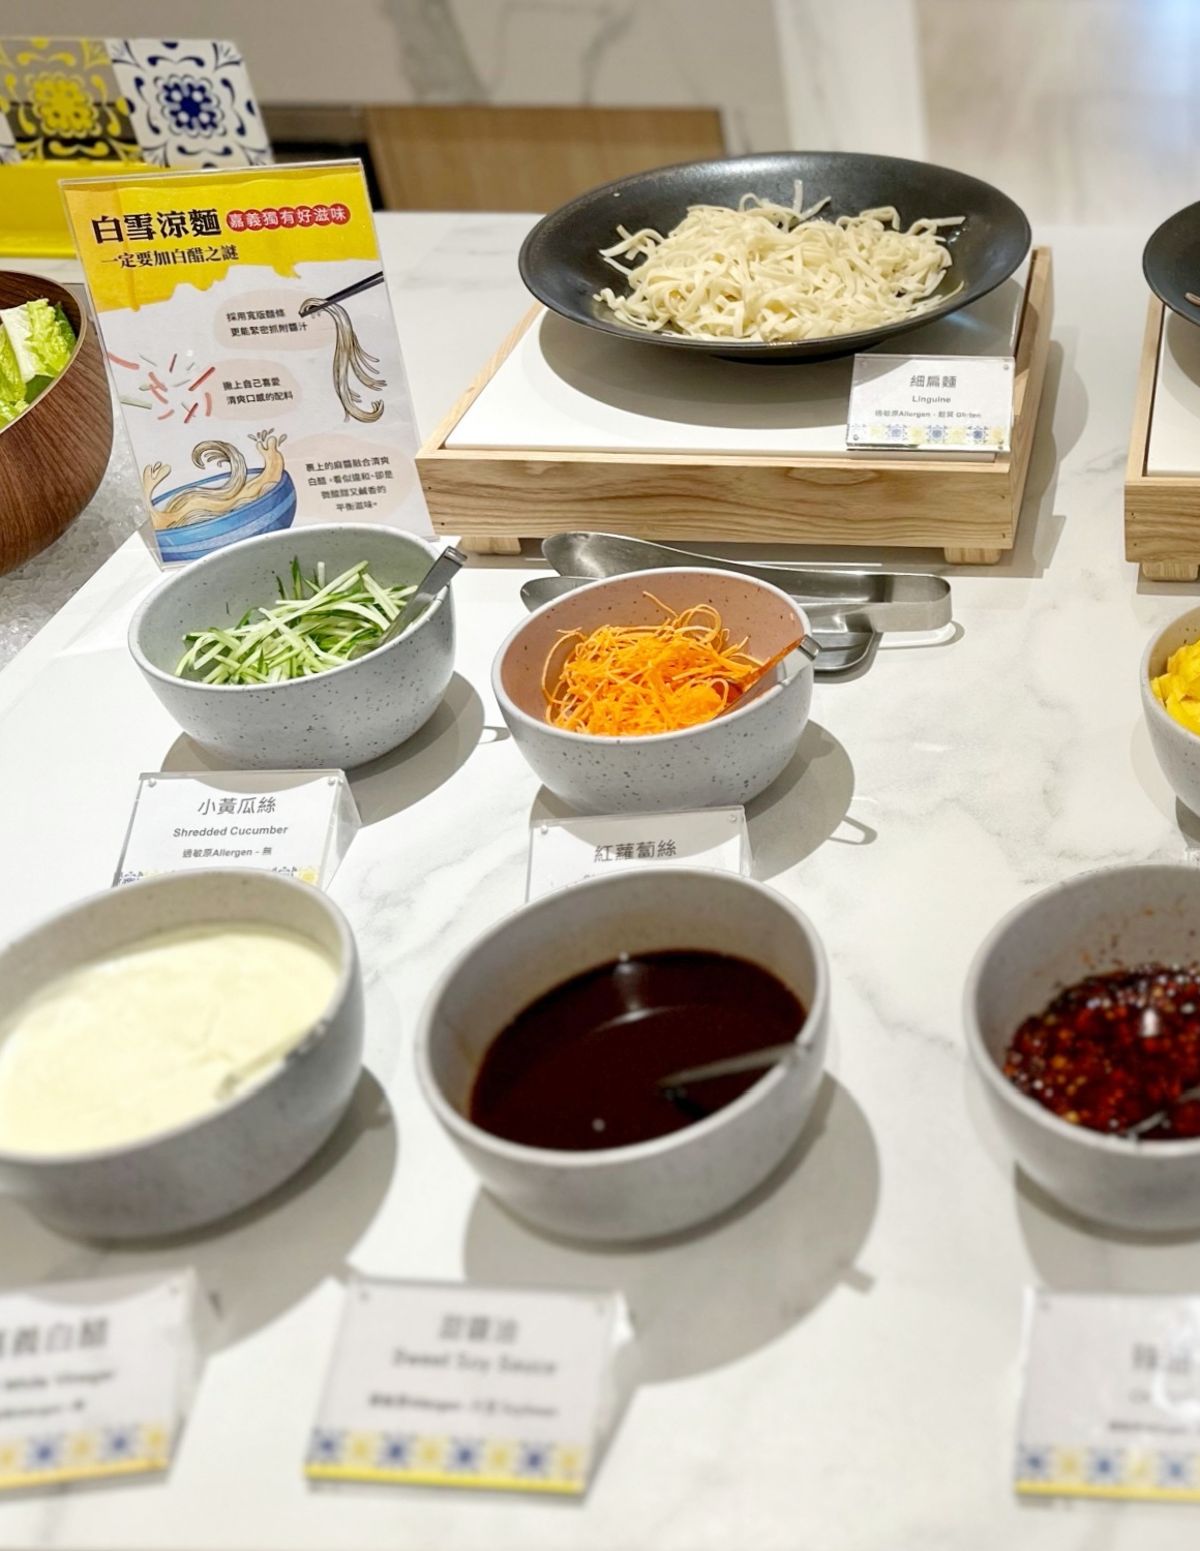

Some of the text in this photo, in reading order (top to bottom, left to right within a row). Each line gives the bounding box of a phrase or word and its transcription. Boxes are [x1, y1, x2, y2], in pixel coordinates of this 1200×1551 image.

[91, 208, 222, 243] 白雪涼麵
[228, 204, 348, 229] 嘉義獨有好滋味
[101, 245, 239, 269] 一定要加白醋之謎
[910, 375, 957, 389] 細扁麵
[912, 395, 952, 404] Linguine
[197, 796, 277, 815] 小黃瓜絲
[172, 825, 289, 838] Shredded Cucumber
[593, 839, 677, 863] 紅蘿蔔絲
